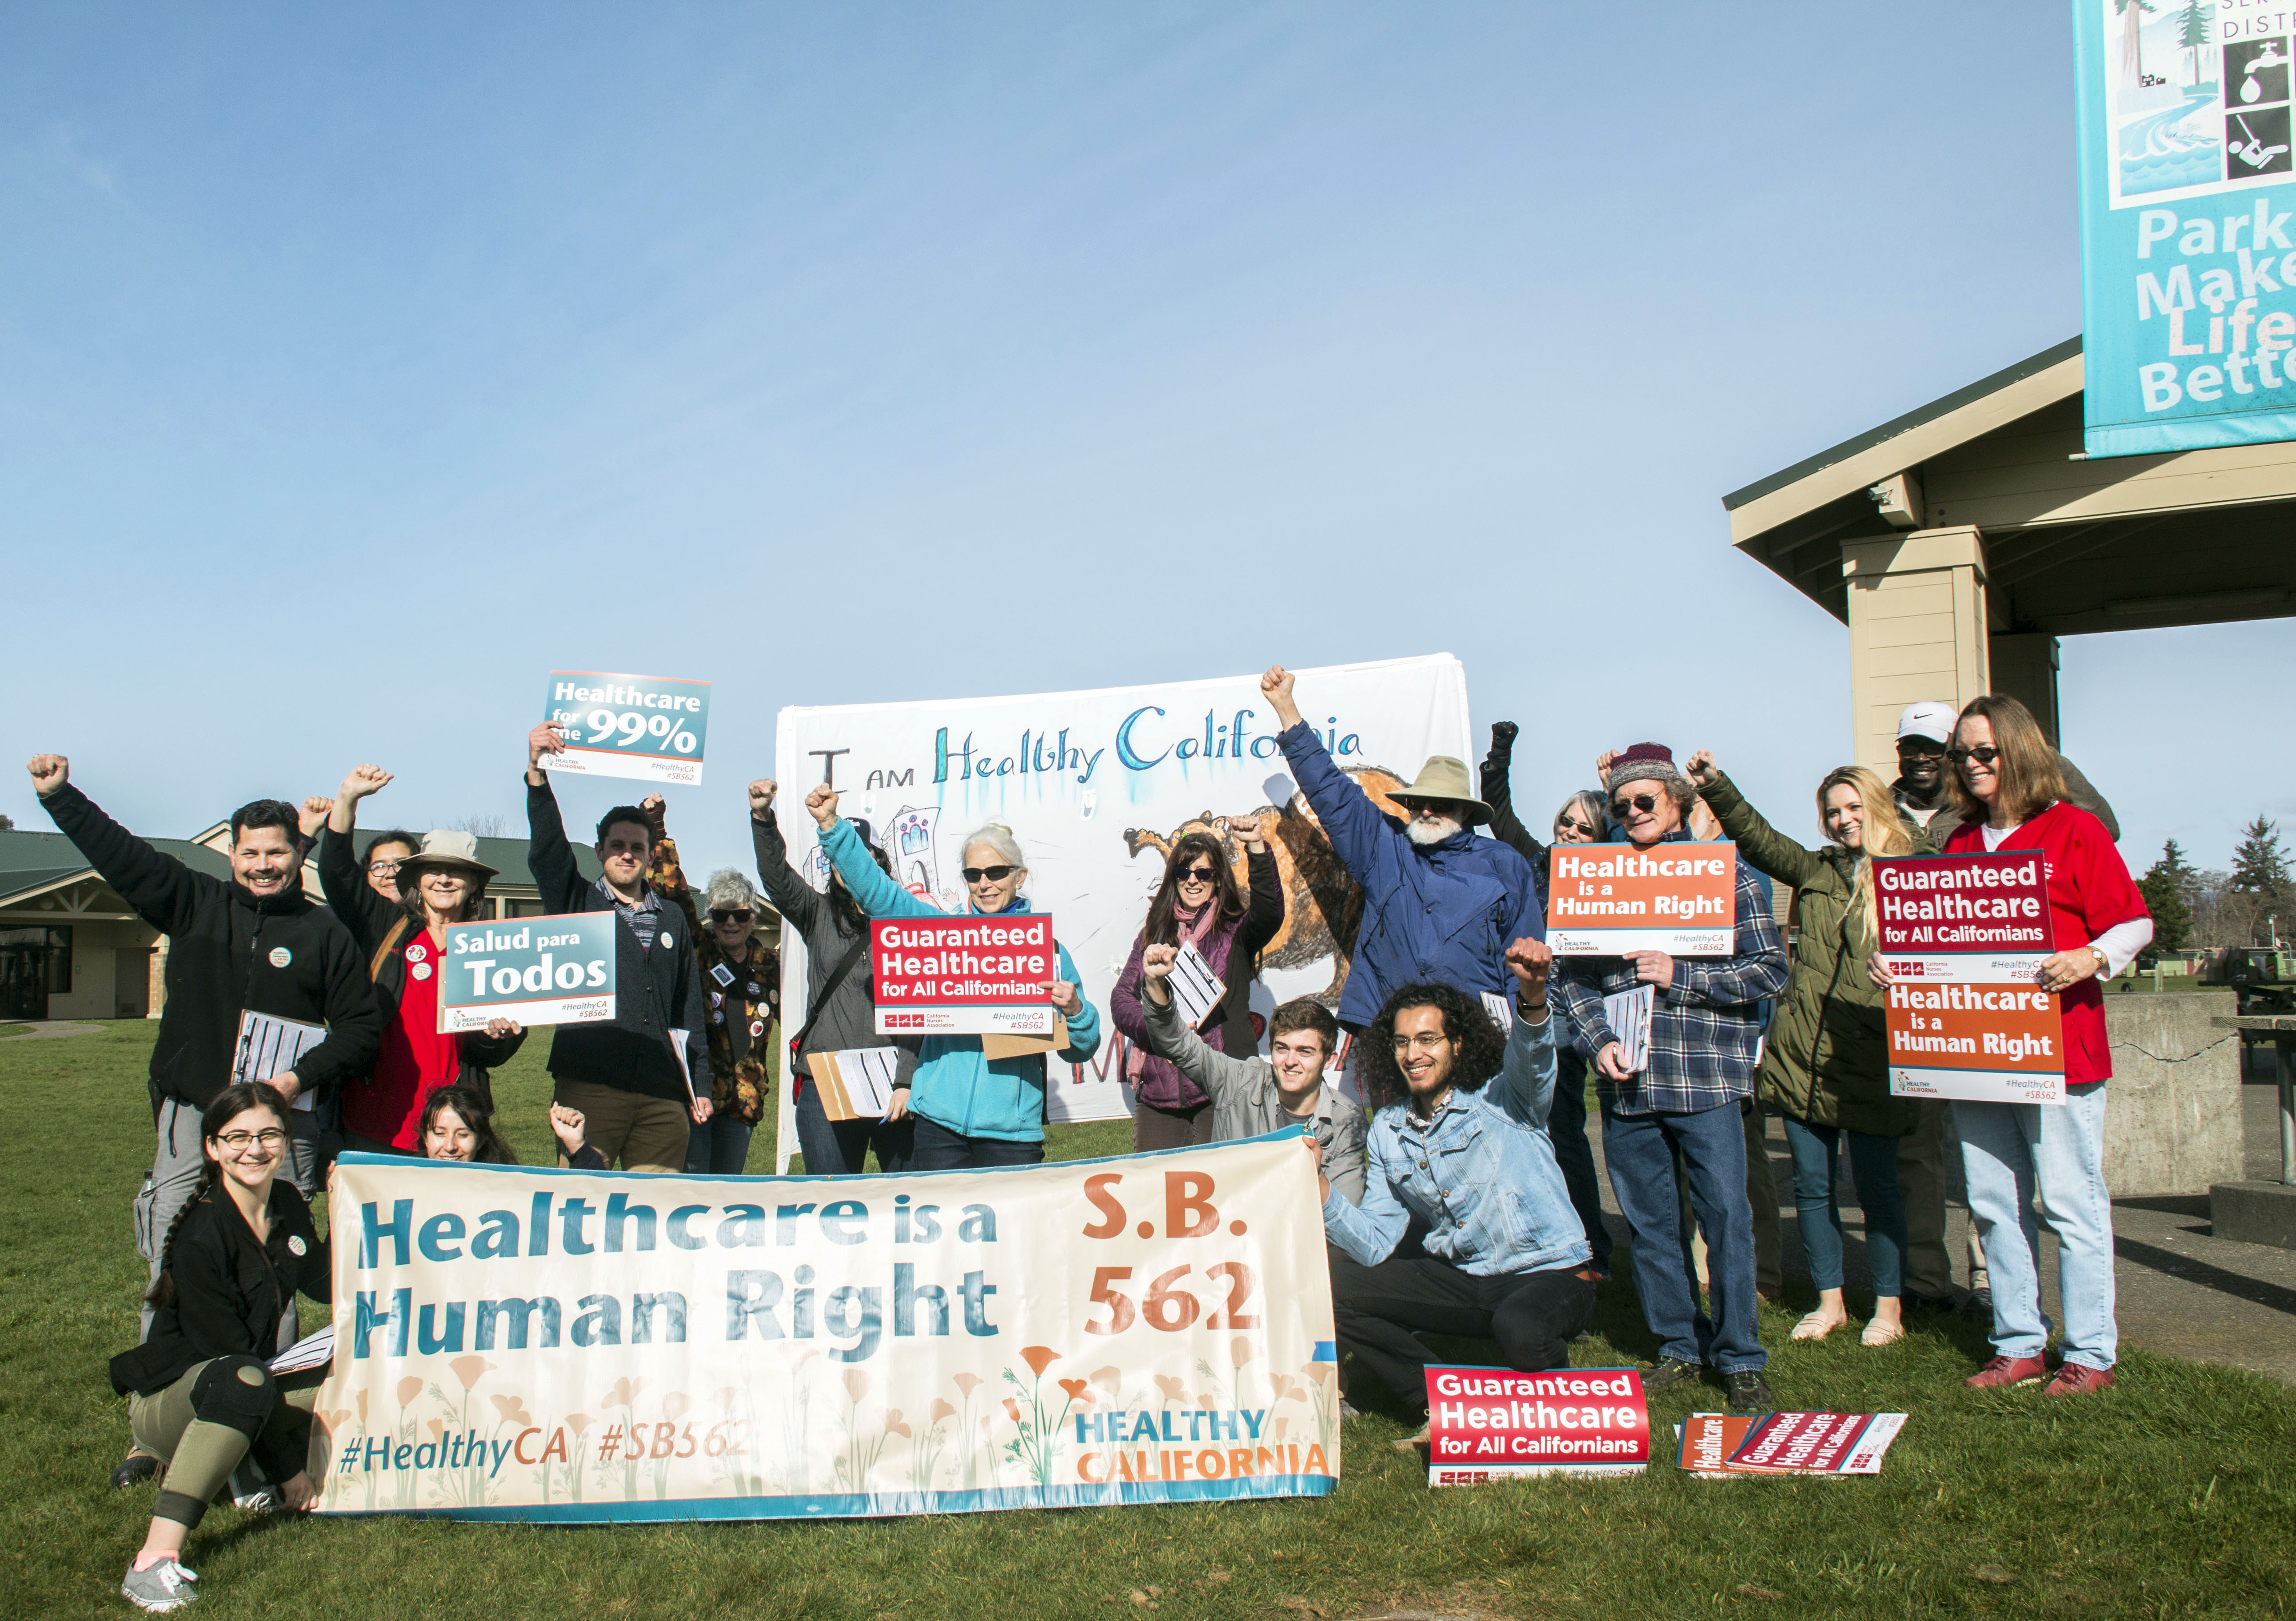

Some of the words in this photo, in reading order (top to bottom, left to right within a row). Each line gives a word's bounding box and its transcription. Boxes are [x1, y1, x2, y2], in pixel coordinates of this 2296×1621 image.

[2169, 298, 2295, 356] Life
[555, 682, 701, 712] Healthcare
[552, 708, 580, 723] for
[587, 709, 697, 753] 99%
[866, 768, 914, 791] AM
[932, 727, 1105, 784] Healthy
[1116, 706, 1363, 771] Califoia
[651, 762, 694, 773] #HealthyCA
[667, 773, 694, 781] #SB562
[1558, 854, 1725, 878] Healthcare
[1880, 860, 2037, 891] Guaranteed
[1579, 881, 1594, 896] is
[1601, 884, 1613, 896] a
[1557, 897, 1646, 915] Human
[1655, 894, 1724, 920] Right
[1883, 893, 2040, 920] Healthcare
[454, 927, 530, 954] Salud
[537, 934, 580, 952] para
[880, 922, 1044, 948] Guaranteed
[1673, 934, 1724, 943] #HealthyCA
[1885, 926, 1907, 942] for
[1911, 926, 1933, 942] All
[1937, 925, 2044, 942] Californians
[463, 953, 607, 996] Todos
[882, 951, 1045, 975] Healthcare
[1991, 960, 2041, 970] #HealthyC
[882, 981, 908, 997] for
[912, 981, 936, 996] All
[941, 979, 1045, 996] Californians
[1890, 984, 2049, 1011] Healthcare
[562, 1001, 607, 1011] #HealthyCA
[579, 1009, 607, 1018] #SB562
[993, 1012, 1044, 1021] #HealthyCA
[1911, 1012, 1925, 1030] is
[1931, 1017, 1942, 1030] a
[1894, 1030, 1976, 1053] Human
[1983, 1032, 2053, 1062] Right
[2006, 1079, 2055, 1089] #HealthyCA
[2025, 1090, 2056, 1100] #SB562
[1082, 1171, 1248, 1240] S.B.
[357, 1191, 869, 1270] Healthcare
[894, 1194, 943, 1244] is
[958, 1203, 998, 1243] a
[1083, 1261, 1261, 1335] 562
[353, 1287, 687, 1360] Human
[725, 1262, 999, 1363] Right
[1437, 1374, 1633, 1396] Guaranteed
[1076, 1409, 1265, 1444] HEALTHY
[1440, 1401, 1637, 1429] Healthcare
[1440, 1436, 1471, 1454] for
[1476, 1436, 1505, 1454] All
[1511, 1436, 1638, 1453] Californians
[1693, 1419, 1724, 1469] Healthcare
[1742, 1413, 1805, 1463] Guaranteed
[1773, 1414, 1837, 1466] Healthcare
[1824, 1415, 1862, 1448] Californians
[340, 1426, 568, 1478] #HealthyCA
[599, 1418, 755, 1461] #SB562
[1817, 1448, 1838, 1458] All
[1077, 1443, 1330, 1483] CALIFORNIA
